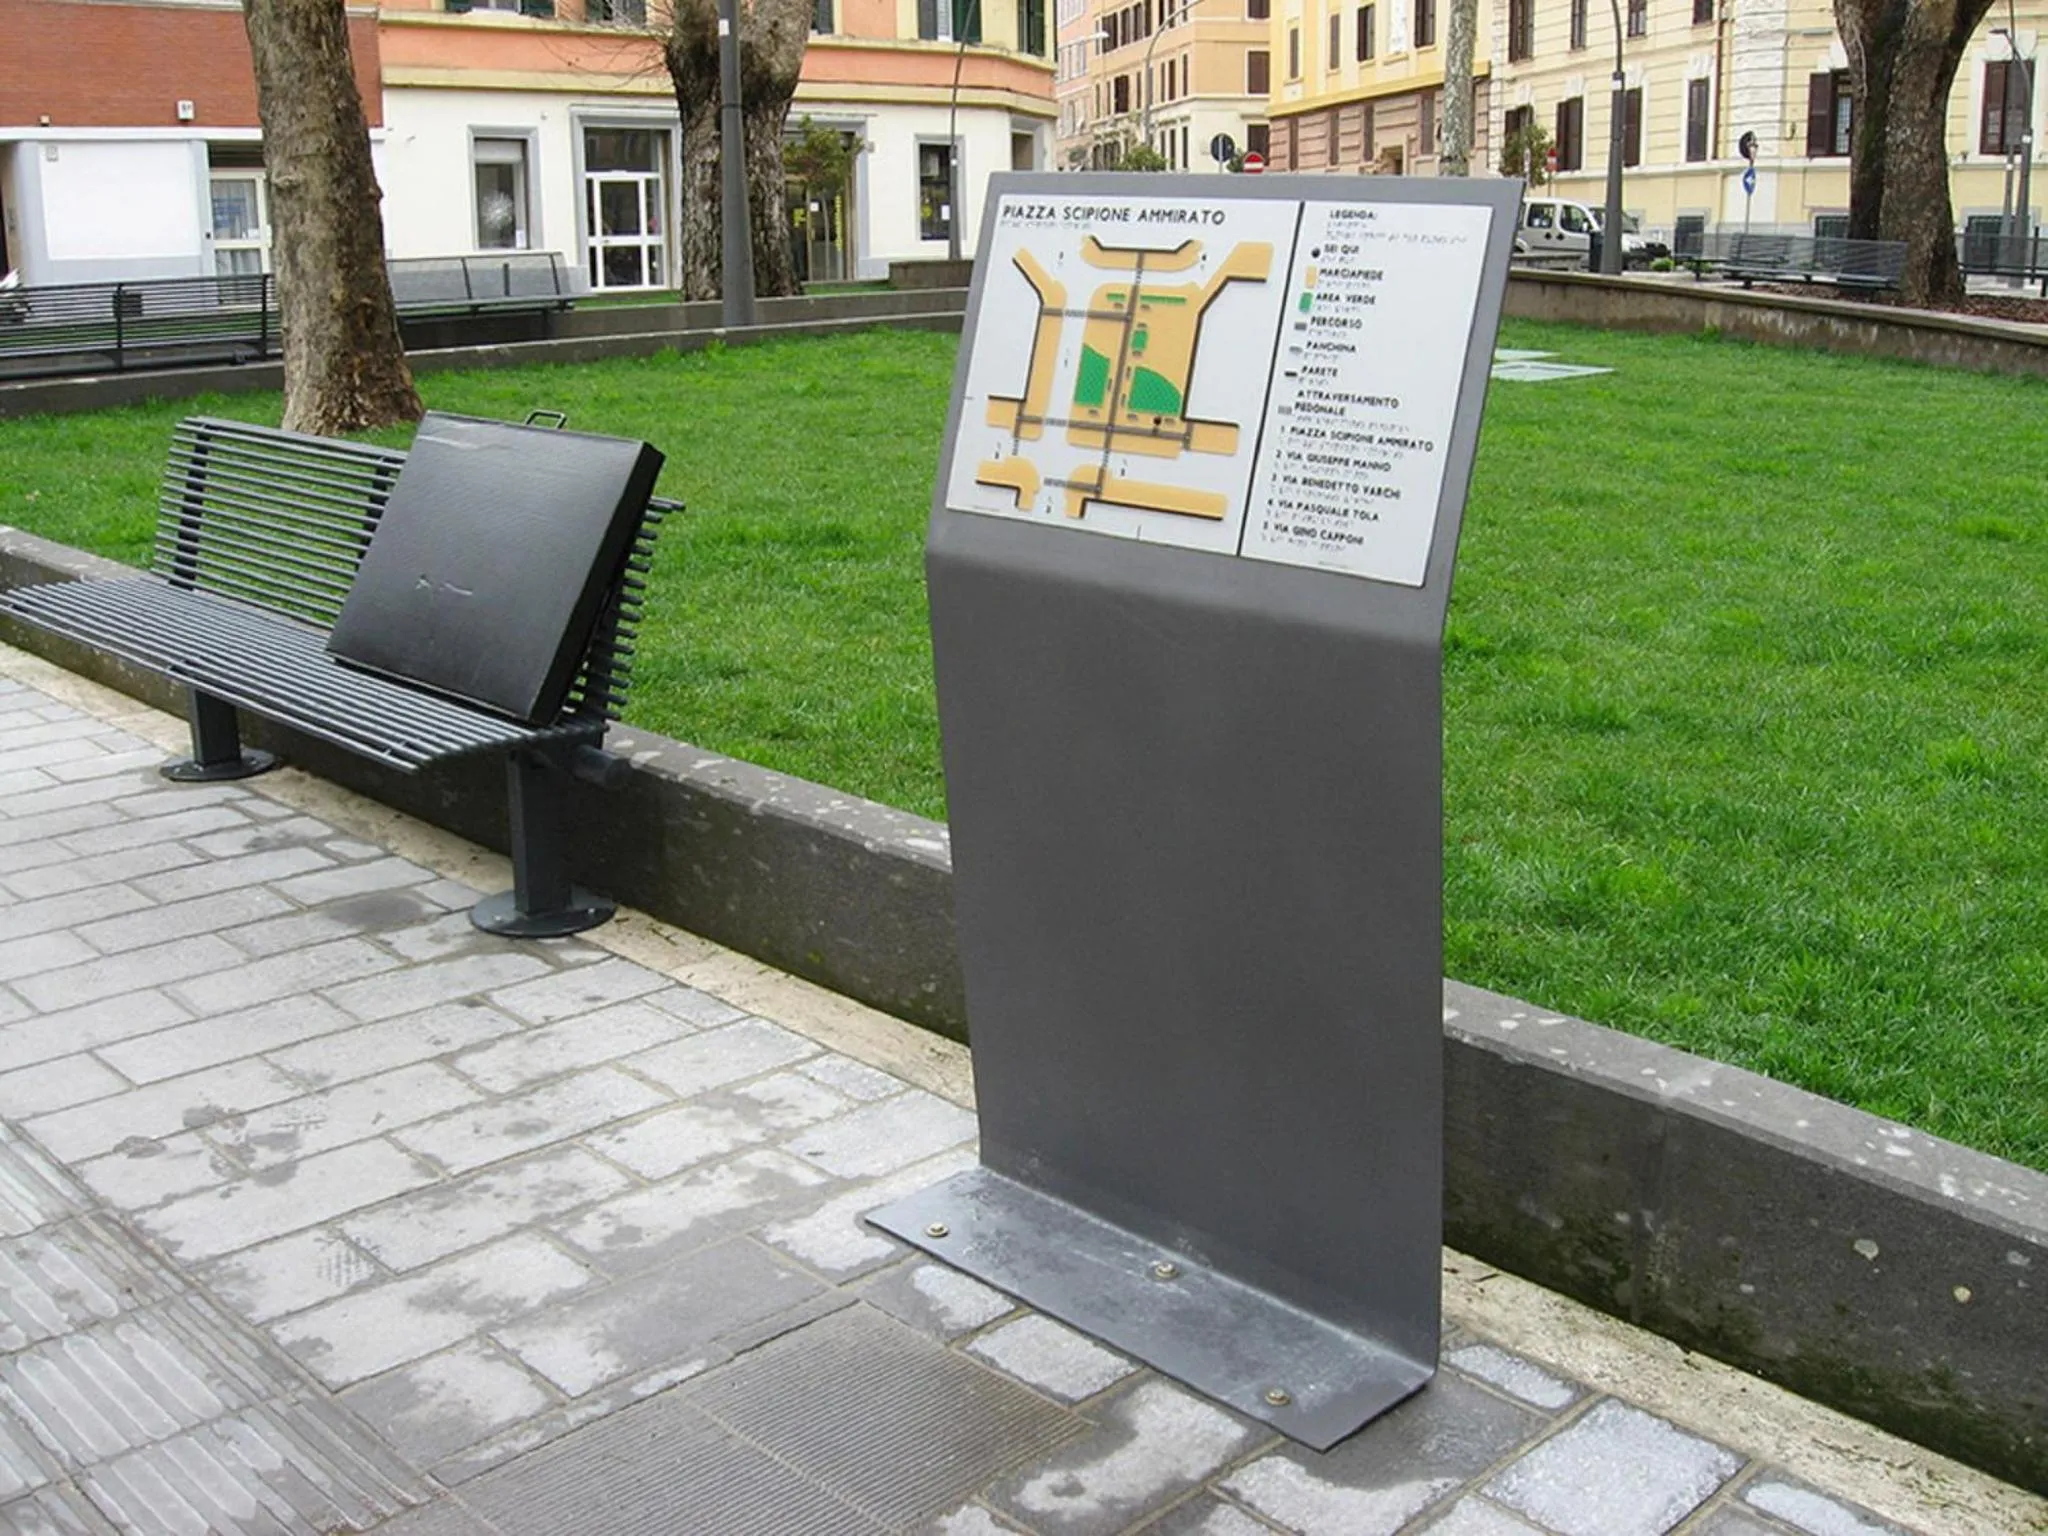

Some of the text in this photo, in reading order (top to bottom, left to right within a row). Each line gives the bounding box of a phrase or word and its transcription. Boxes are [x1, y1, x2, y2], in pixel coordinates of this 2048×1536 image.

[1002, 205, 1225, 225] PIAZZA SCIPIONE AMMIRATO
[1325, 244, 1360, 255] SEI QUI
[1320, 268, 1384, 281] MARCIAPIEDE
[1316, 293, 1376, 305] AREA VERDE
[1311, 317, 1363, 330] PERCORSO
[1306, 341, 1357, 354] PANCHINA
[1302, 366, 1338, 377] PARETE
[1297, 389, 1400, 409] ATTRAVERSAMENTO
[1295, 402, 1346, 416] PEDONALE
[1290, 426, 1327, 439] PIAZZA
[1331, 430, 1374, 445] SCIPIONE
[1378, 435, 1434, 452] AMMIRATO
[1287, 451, 1303, 462] VIA
[1307, 453, 1350, 468] GIUSEPPE
[1354, 458, 1391, 472] MANNO
[1283, 475, 1298, 486] VIA
[1302, 477, 1358, 494] BENEDETTO
[1363, 484, 1401, 499] VARCHI
[1279, 499, 1294, 511] VIA
[1297, 501, 1349, 517] PASQUALE
[1353, 509, 1380, 522] TOLA
[1274, 523, 1289, 534] VIA
[1293, 525, 1317, 539] GINO
[1320, 529, 1364, 546] CAPPONI
